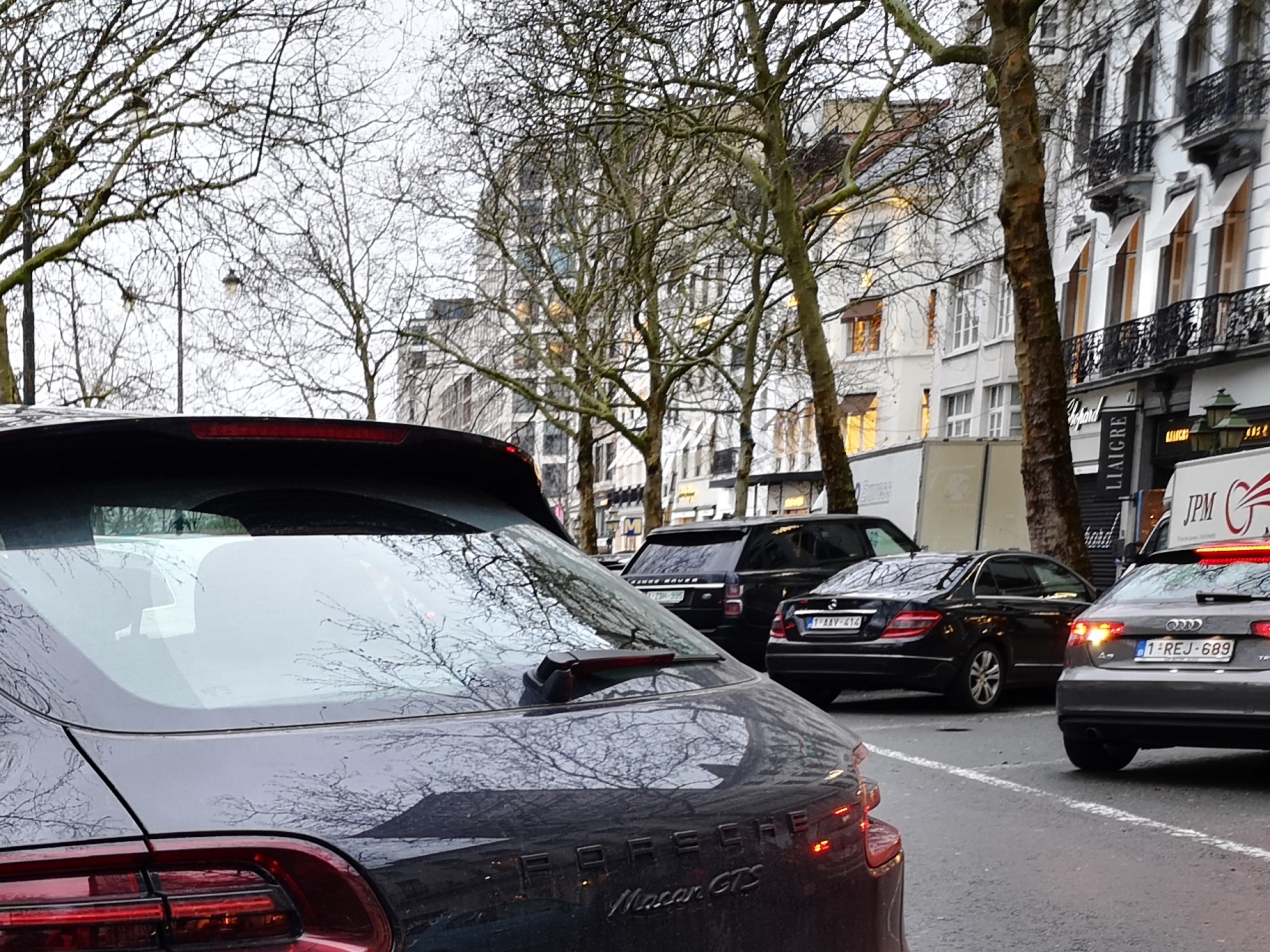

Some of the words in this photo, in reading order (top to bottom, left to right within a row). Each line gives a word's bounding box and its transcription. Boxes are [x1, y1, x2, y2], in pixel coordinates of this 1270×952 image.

[1105, 416, 1127, 490] LIAIGRE
[625, 518, 642, 535] M
[1183, 492, 1217, 526] JPM
[1148, 642, 1230, 656] 1-REJ-689
[520, 810, 809, 878] PORSCHE
[607, 883, 705, 918] Macan
[707, 864, 765, 897] GTS
